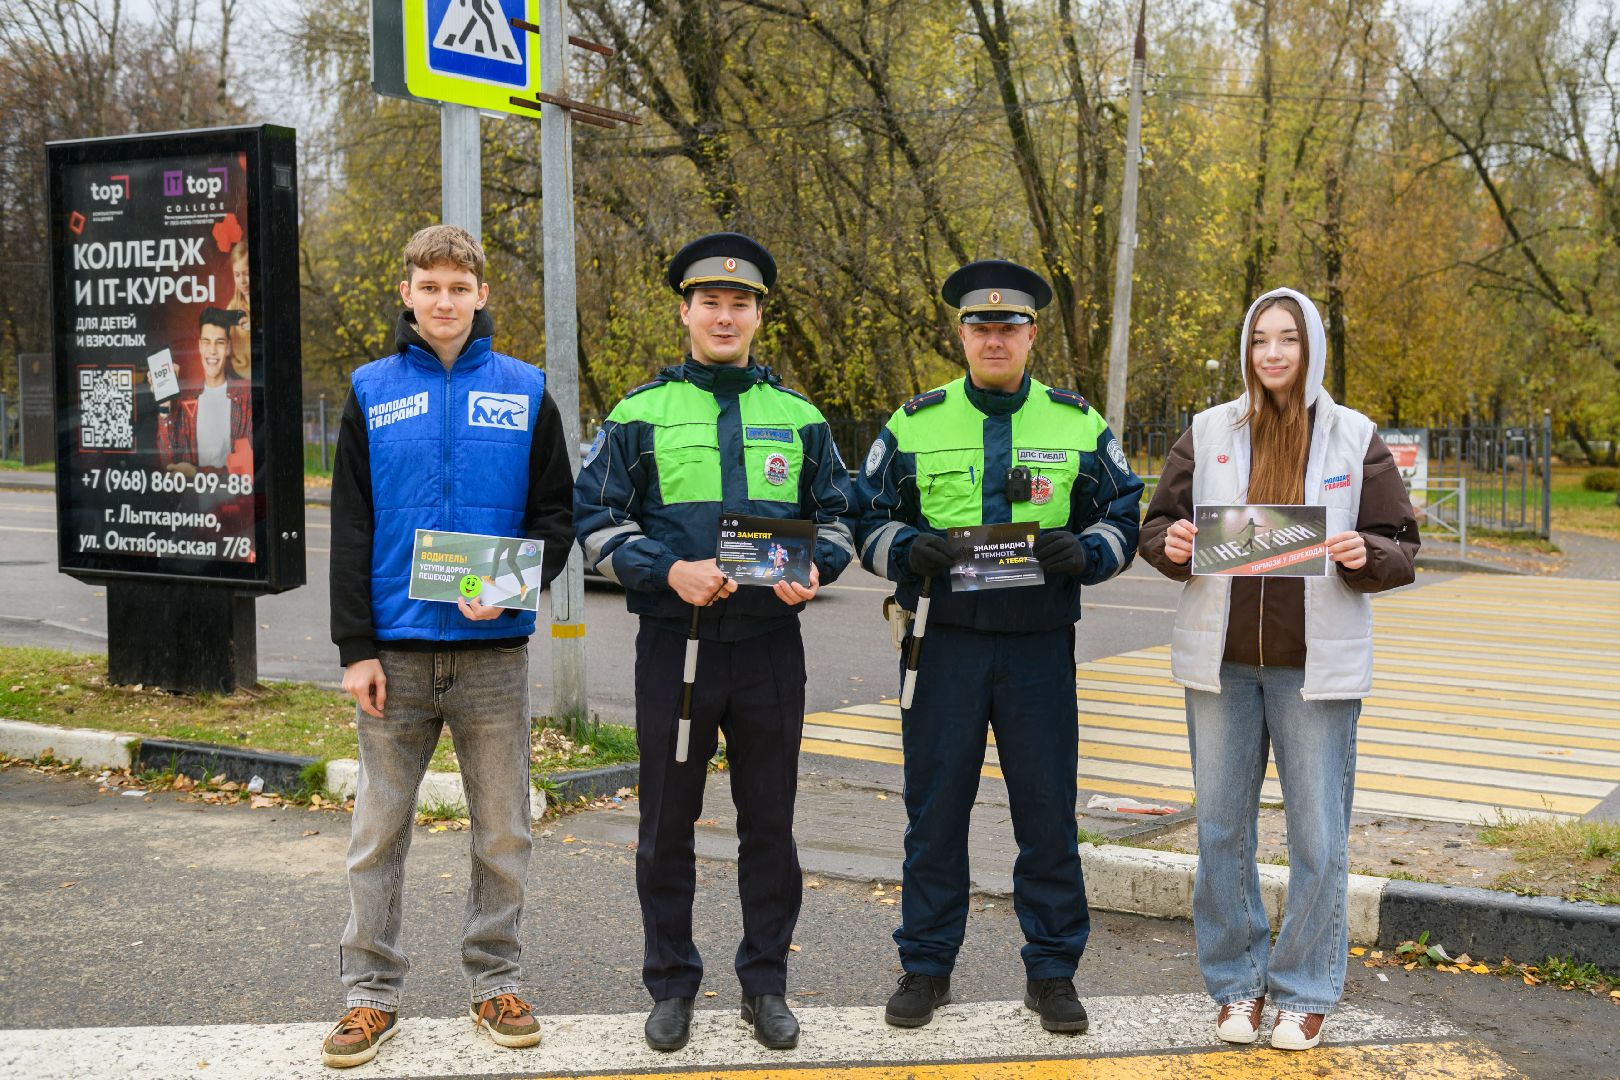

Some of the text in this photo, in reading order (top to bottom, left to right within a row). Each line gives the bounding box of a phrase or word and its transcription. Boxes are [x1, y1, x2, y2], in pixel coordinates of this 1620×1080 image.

[91, 182, 123, 204] top
[186, 174, 222, 198] top
[166, 202, 225, 213] COLLEGE
[73, 237, 205, 272] КОЛЛЕДЖ
[75, 275, 216, 306] И IT-КУРСЫ
[76, 313, 136, 332] ДЛЯ ДЕТЕЙ
[77, 333, 146, 348] И ВЗРОСЛЫХ
[1020, 451, 1065, 460] ДПС ГИБДД
[82, 468, 253, 495] +7 (968) 860-09-88
[105, 504, 221, 532] г. Лыткарино,
[721, 530, 773, 539] ЕГО ЗАМЕТЯТ
[79, 531, 251, 559] ул. Октябрьская 7/8
[973, 541, 1026, 552] ЗНАКИ ВИДНО
[1213, 540, 1250, 561] НЕ
[421, 551, 468, 564] ВОДИТЕЛЬ!
[1005, 556, 1028, 564] ТЕБЯ?
[1251, 546, 1325, 572] ТОРМОЗИ У ПЕРЕХОДА!
[418, 571, 455, 582] ПЕШЕХОДУ
[419, 563, 471, 575] УСТУПИ ДОРОГУ
